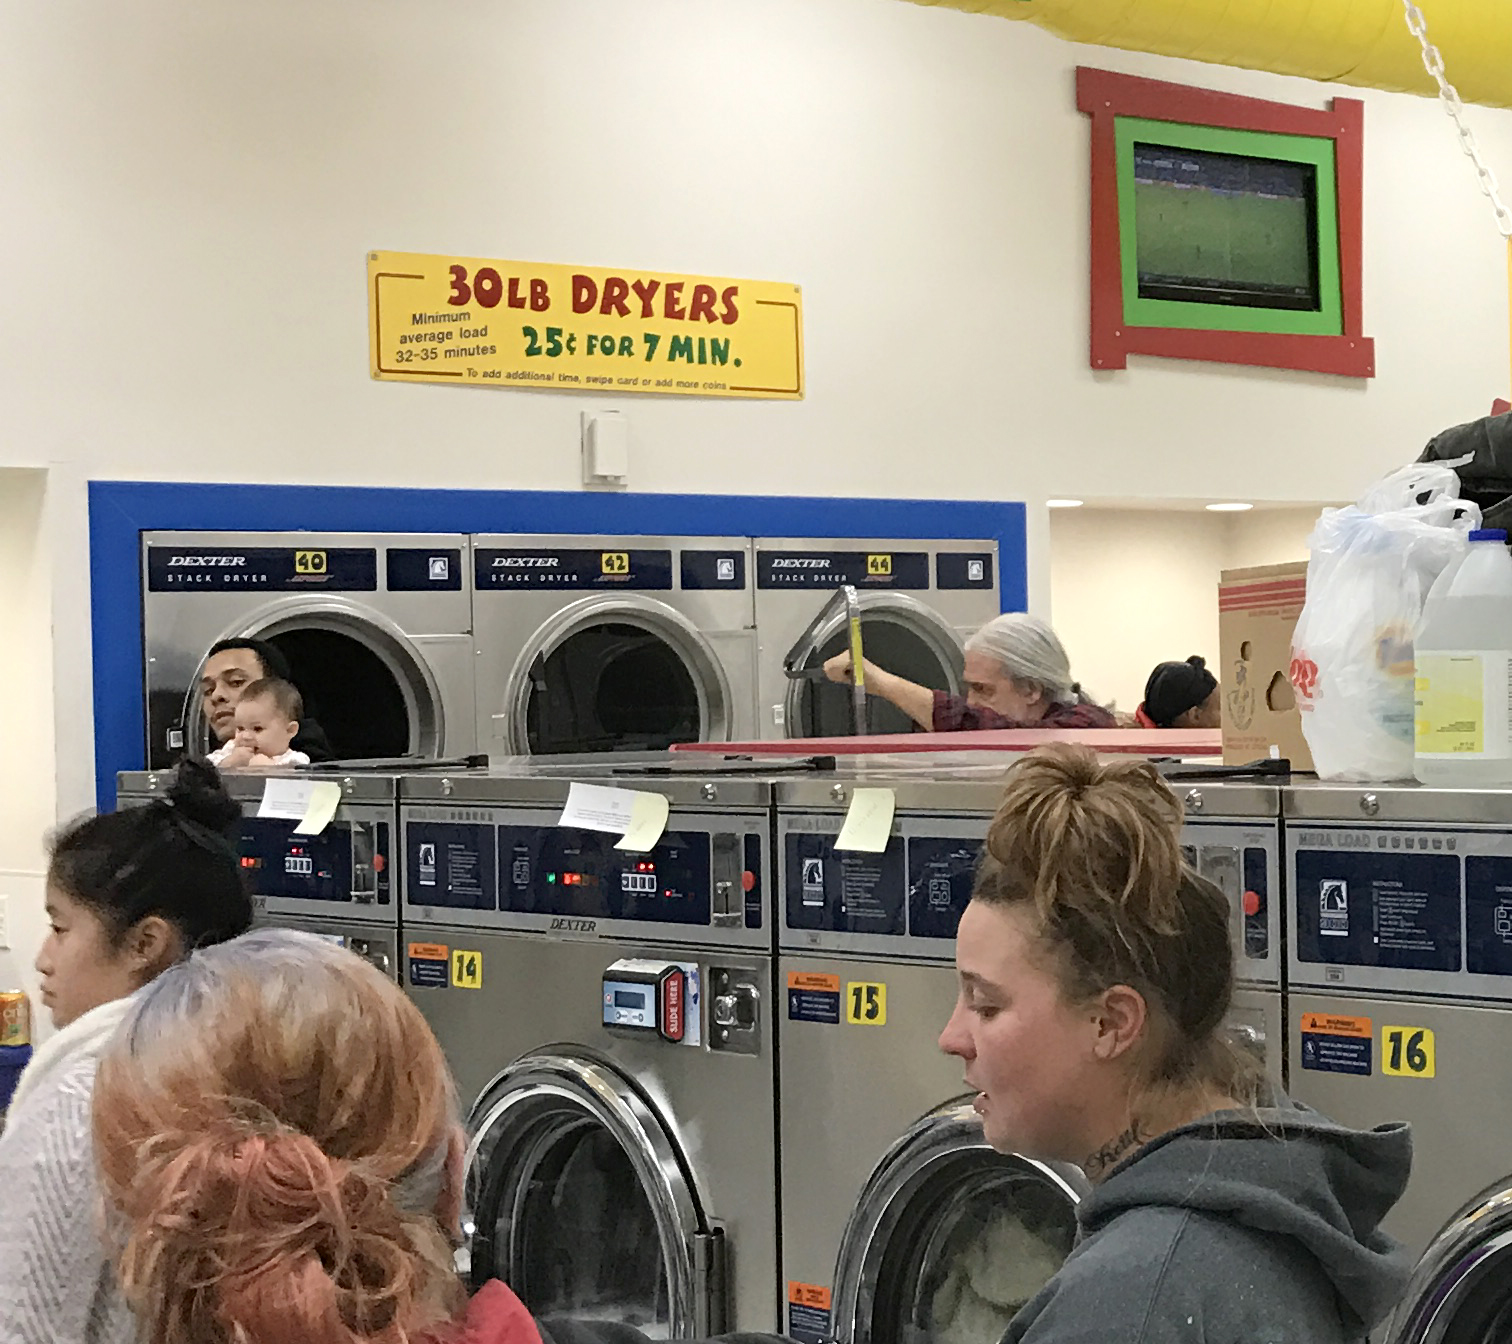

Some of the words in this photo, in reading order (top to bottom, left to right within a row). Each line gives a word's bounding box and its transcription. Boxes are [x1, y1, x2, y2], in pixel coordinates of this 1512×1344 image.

[447, 264, 551, 313] 30LB
[572, 273, 740, 326] DRYERS
[411, 312, 471, 327] Minimum
[400, 329, 453, 346] average
[459, 325, 488, 339] load
[395, 348, 438, 364] 32-35
[444, 345, 497, 359] minutes
[522, 325, 577, 358] 25¢
[586, 333, 635, 358] FOR
[643, 333, 661, 363] 7
[669, 335, 742, 368] MIN.
[466, 367, 478, 378] To
[482, 370, 502, 379] add
[505, 371, 555, 381] additional
[558, 373, 582, 384] time,
[585, 375, 613, 385] swipe
[617, 377, 639, 386] card
[642, 378, 652, 386] or
[655, 378, 673, 387] add
[676, 380, 699, 388] more
[702, 381, 727, 390] coins
[167, 556, 247, 566] DEXTER
[297, 553, 325, 571] 40
[491, 558, 560, 567] DEXTER
[604, 554, 627, 572] 42
[771, 558, 832, 568] DEXTER
[870, 557, 890, 572] 44
[167, 574, 213, 583] STACK
[223, 574, 267, 583] DRYER
[491, 574, 530, 582] STACK
[540, 574, 578, 583] DRYER
[771, 574, 805, 582] STACK
[813, 574, 847, 583] DRYER
[550, 918, 597, 932] DEXTER
[456, 955, 477, 984] 14
[670, 979, 678, 1005] HERE
[852, 985, 879, 1020] 15
[670, 1006, 678, 1033] SLIDE
[1389, 1030, 1427, 1072] 16
